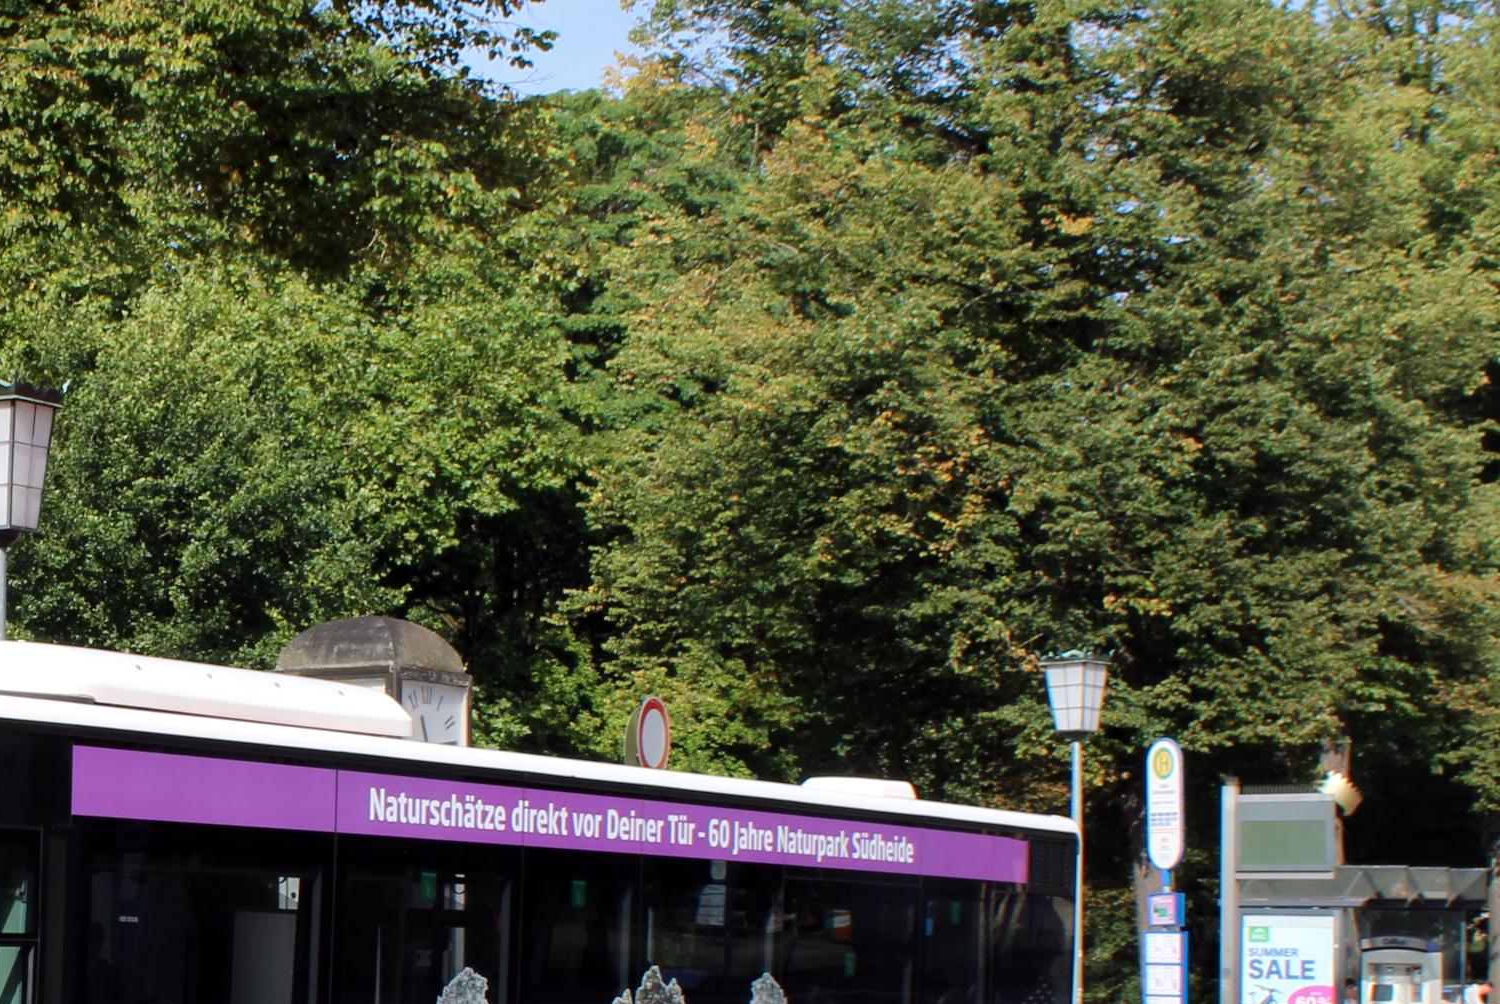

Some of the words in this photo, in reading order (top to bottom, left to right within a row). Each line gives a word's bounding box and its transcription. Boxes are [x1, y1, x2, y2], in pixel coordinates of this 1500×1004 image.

[368, 787, 507, 831] Naturschätze
[511, 800, 568, 836] direkt
[572, 811, 602, 838] vor
[606, 808, 664, 843] Deiner
[668, 814, 696, 846] Tür
[708, 817, 730, 849] 60
[732, 820, 774, 855] Jahre
[776, 825, 850, 862] Naturpark
[851, 832, 915, 864] Südheide
[1248, 947, 1299, 957] SUMMER
[1248, 959, 1316, 980] SALE
